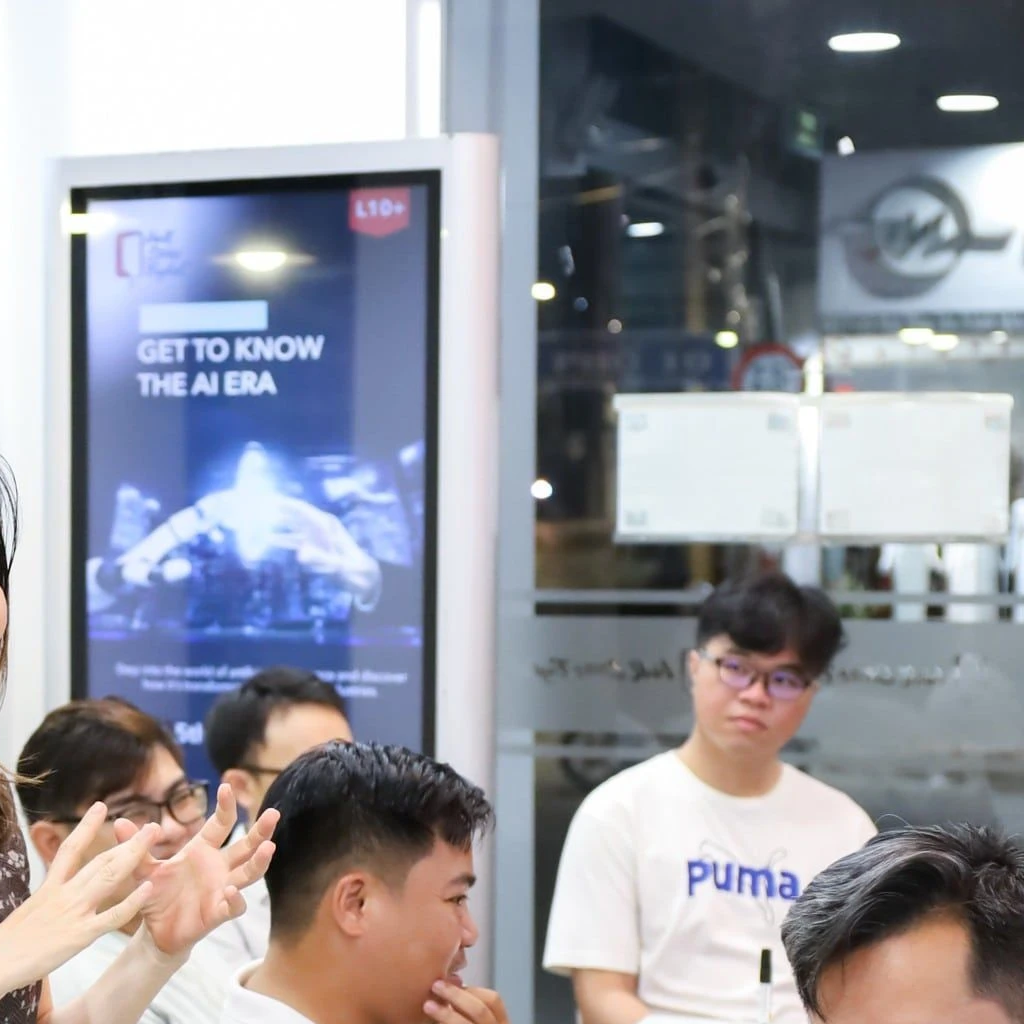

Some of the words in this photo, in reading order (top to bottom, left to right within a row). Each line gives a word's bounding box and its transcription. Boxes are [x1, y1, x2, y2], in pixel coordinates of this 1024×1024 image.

[355, 198, 406, 218] L10+
[136, 337, 188, 364] GET
[191, 336, 230, 363] TO
[234, 334, 325, 362] KNOW
[136, 371, 188, 397] THE
[190, 371, 219, 396] AI
[223, 369, 277, 396] ERA
[686, 859, 800, 900] puma
